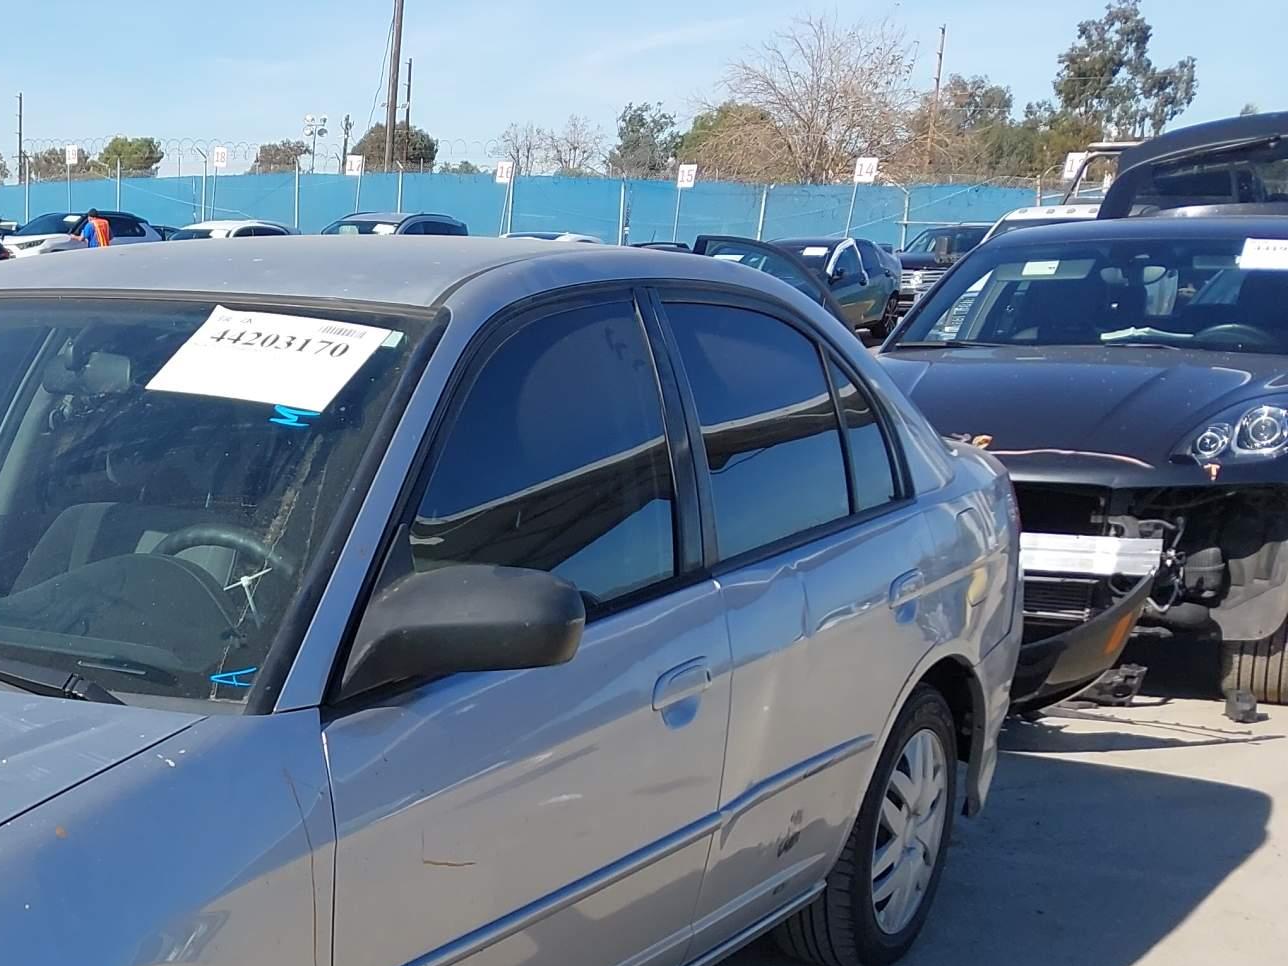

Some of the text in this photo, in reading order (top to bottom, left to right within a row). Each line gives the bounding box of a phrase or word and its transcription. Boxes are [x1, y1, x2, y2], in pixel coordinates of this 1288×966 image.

[68, 149, 77, 160] 19
[215, 151, 226, 163] 18
[347, 159, 362, 172] 17
[856, 163, 875, 177] 14
[679, 169, 695, 183] 15
[210, 329, 351, 358] 44203170
